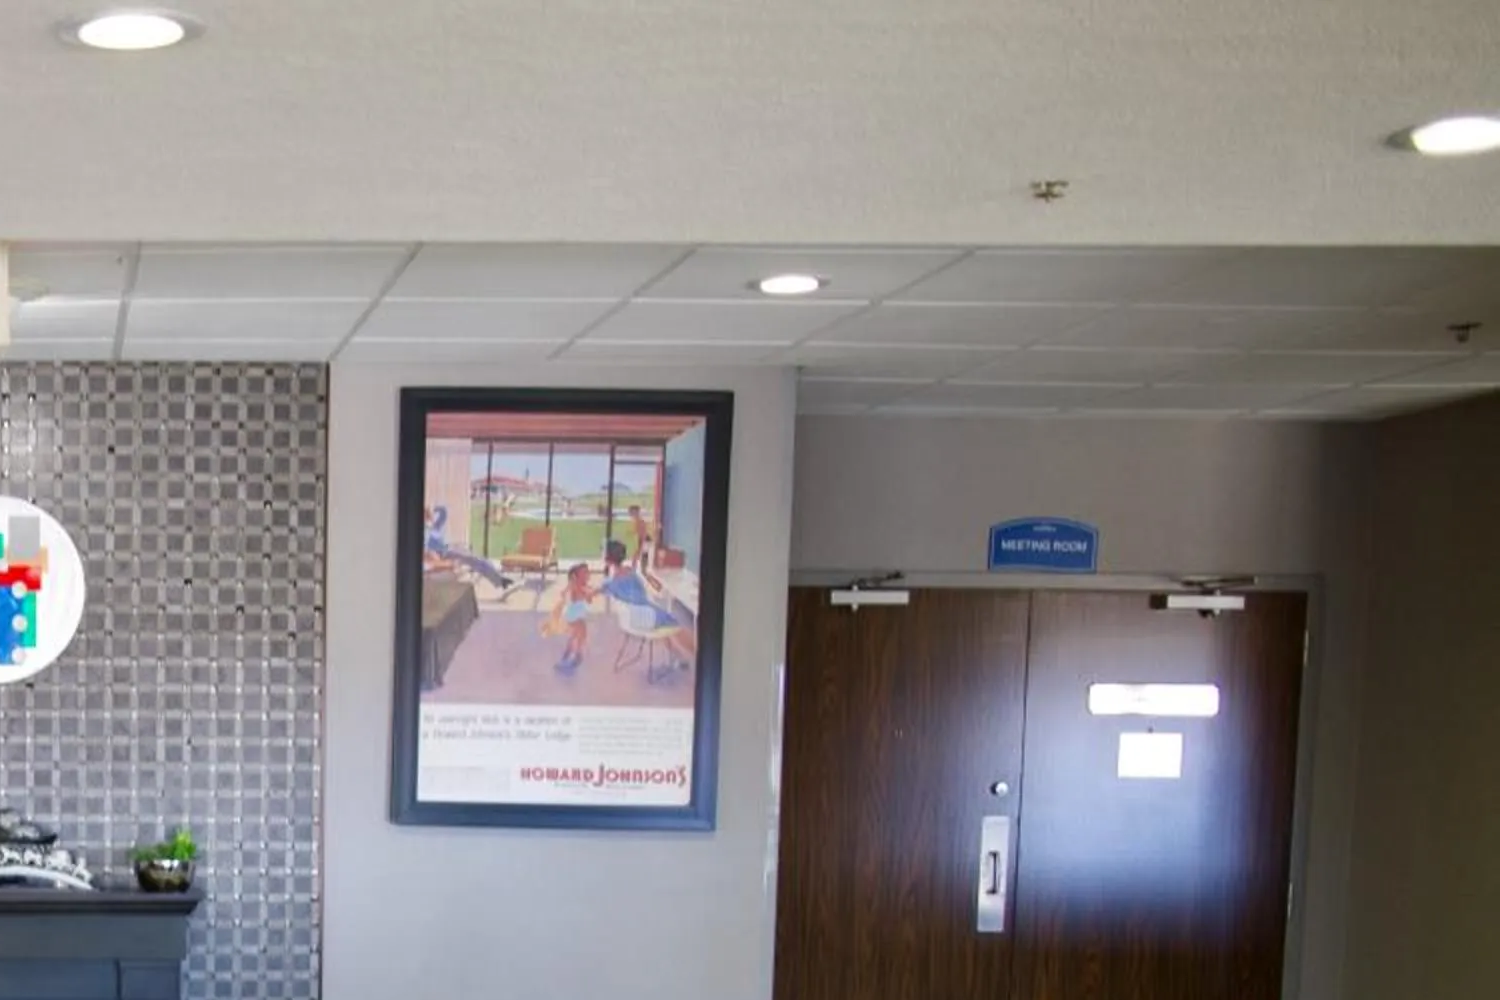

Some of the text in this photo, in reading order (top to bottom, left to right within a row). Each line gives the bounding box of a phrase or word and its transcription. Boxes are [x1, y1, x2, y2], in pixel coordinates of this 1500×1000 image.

[1001, 539, 1088, 553] MEETING ROOM
[520, 766, 594, 783] HOWARD
